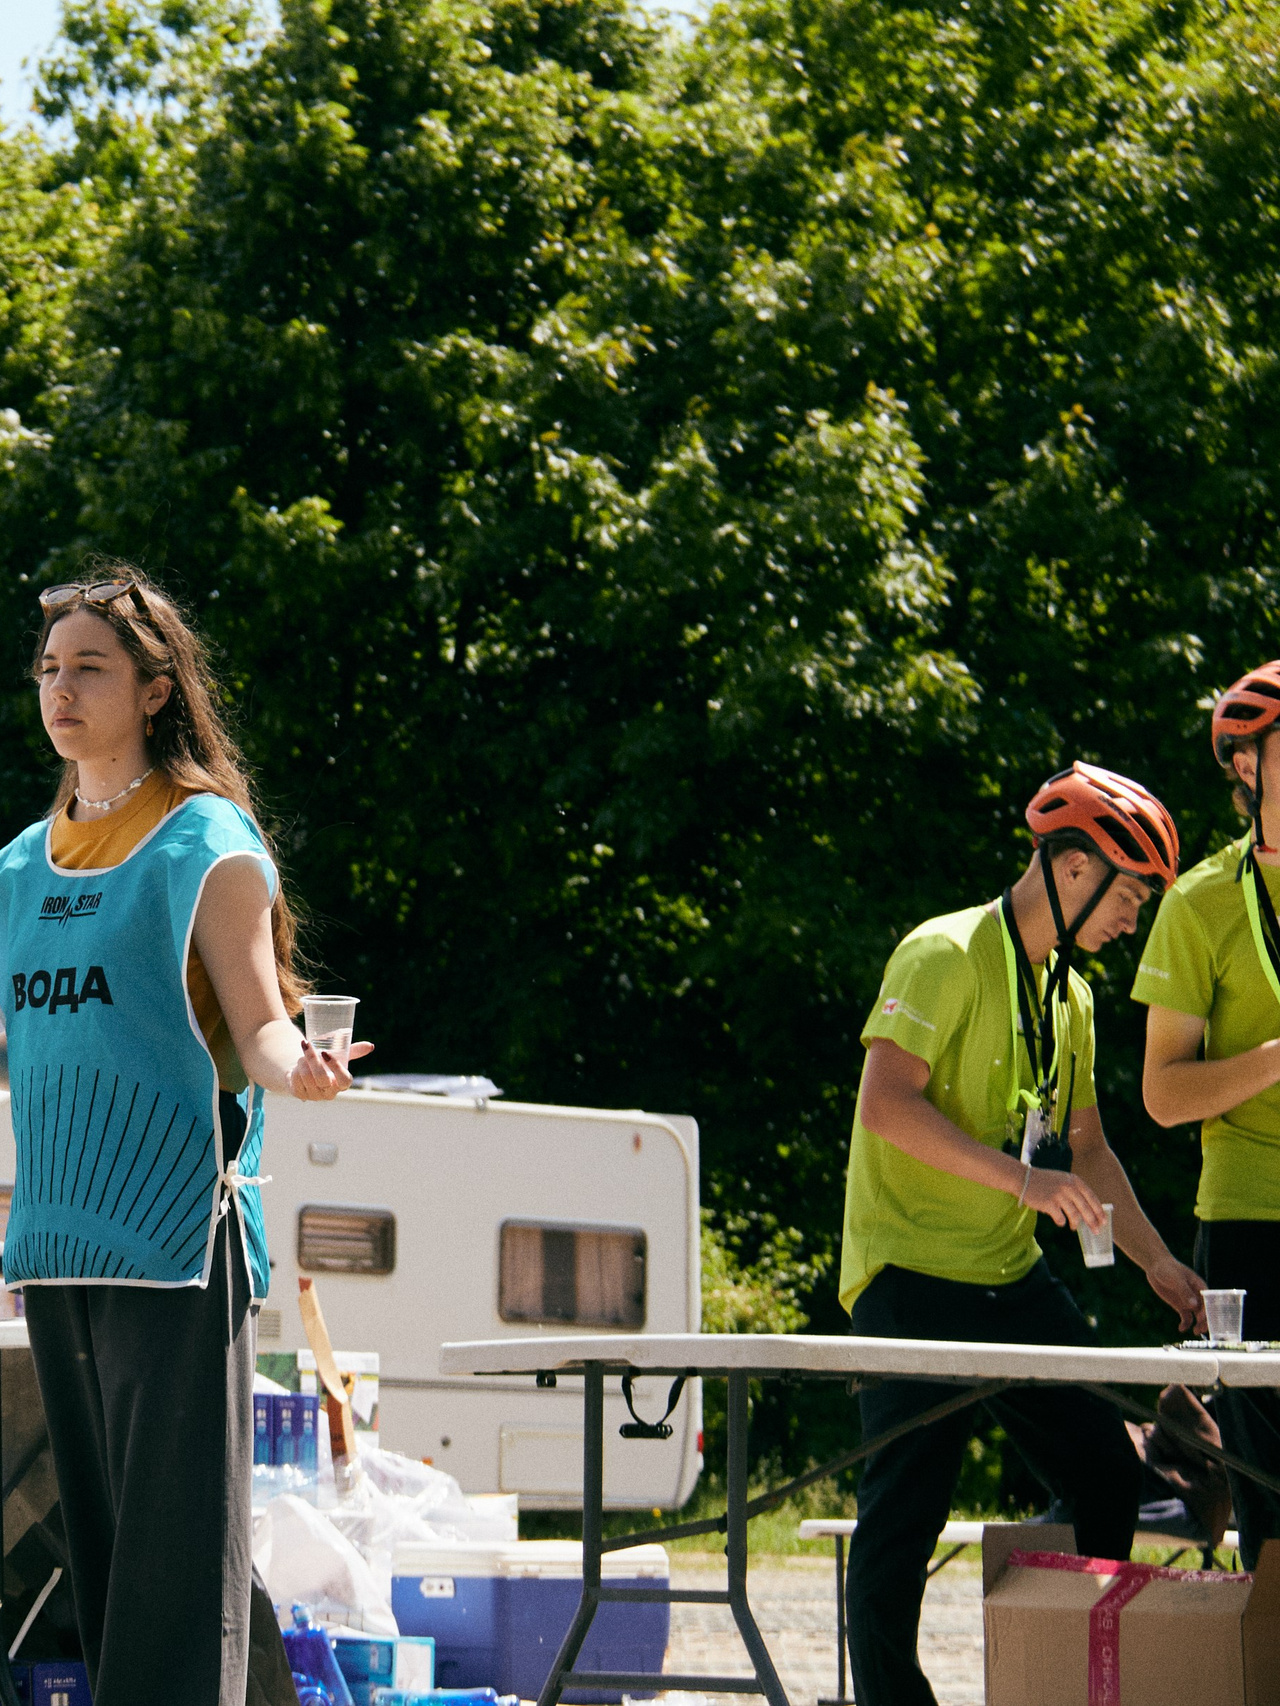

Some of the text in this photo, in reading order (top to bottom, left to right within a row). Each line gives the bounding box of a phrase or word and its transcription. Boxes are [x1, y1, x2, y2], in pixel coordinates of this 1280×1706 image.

[40, 891, 103, 914] IRON STAR
[12, 965, 114, 1015] ВОДА
